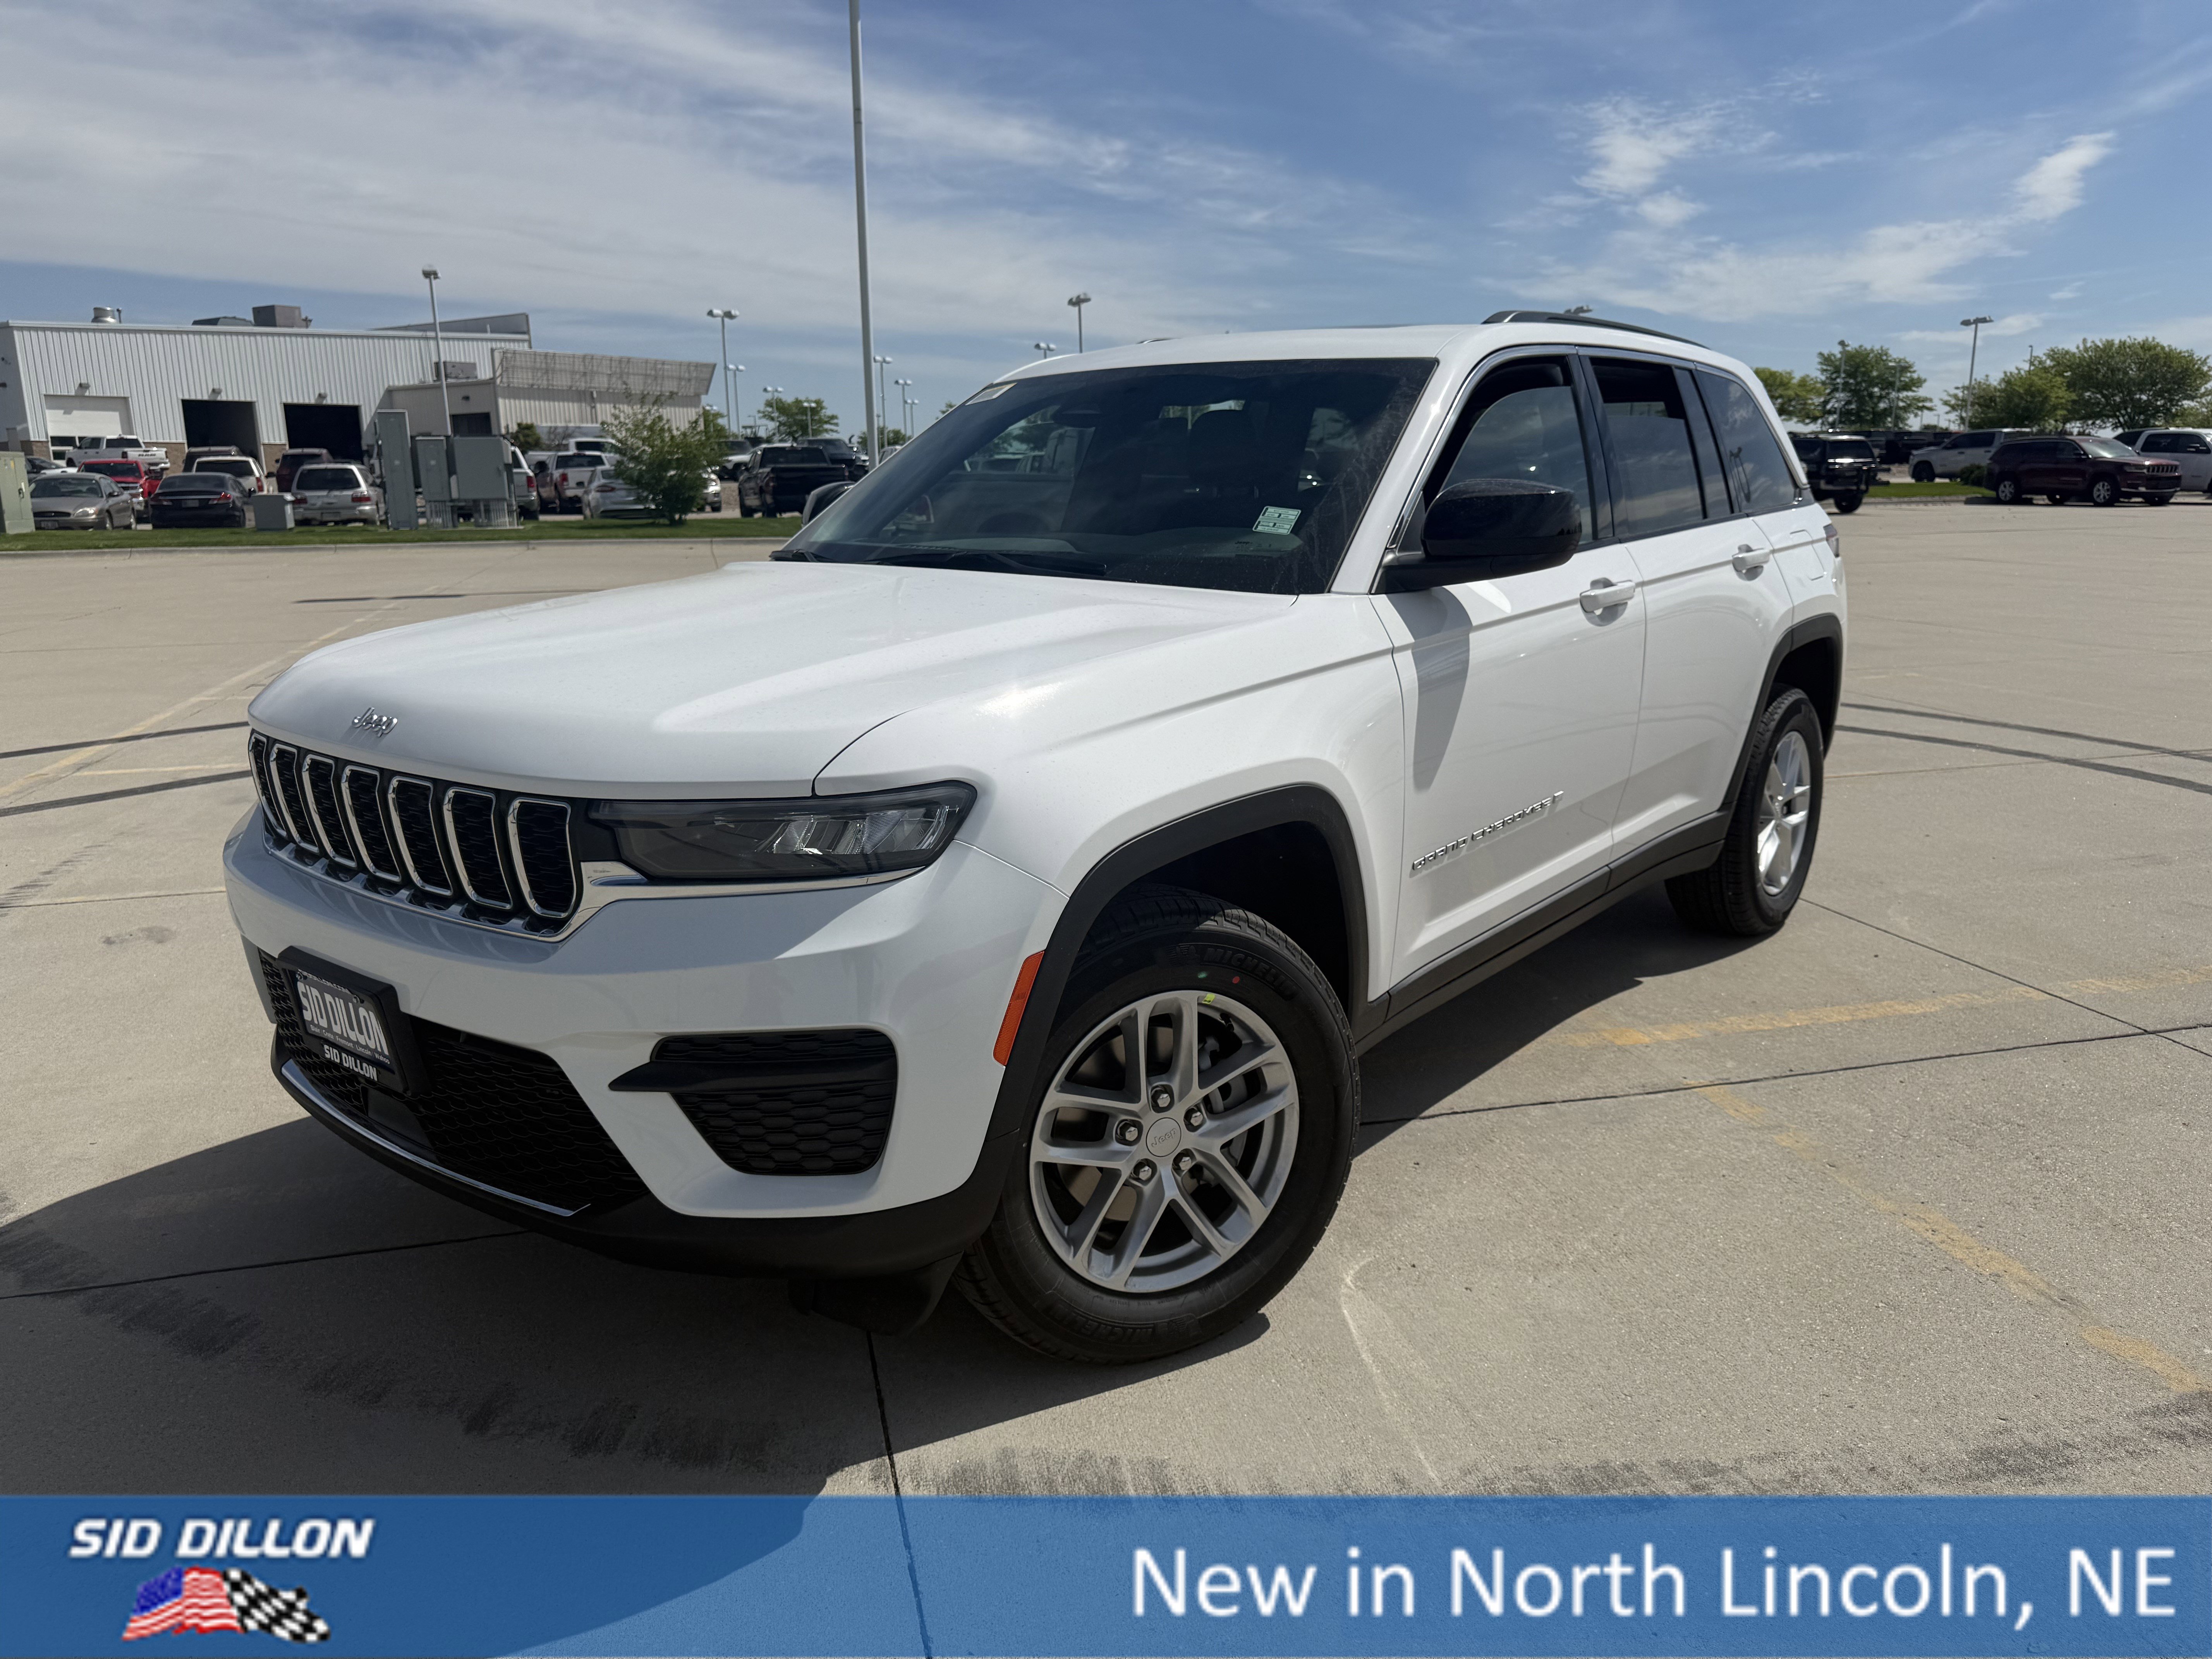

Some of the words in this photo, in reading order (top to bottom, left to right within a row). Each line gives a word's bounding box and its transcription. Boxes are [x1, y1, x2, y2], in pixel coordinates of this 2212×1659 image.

[352, 707, 398, 737] Jeep
[1412, 836, 1468, 870] GRAND
[1471, 797, 1552, 841] CHEROKEE
[1202, 948, 1298, 1001] MICHELIN
[297, 981, 328, 1028] SID
[324, 991, 389, 1055] DILLON
[324, 1044, 340, 1063] SID
[341, 1052, 378, 1081] DILLON
[1151, 1128, 1177, 1148] Jeep
